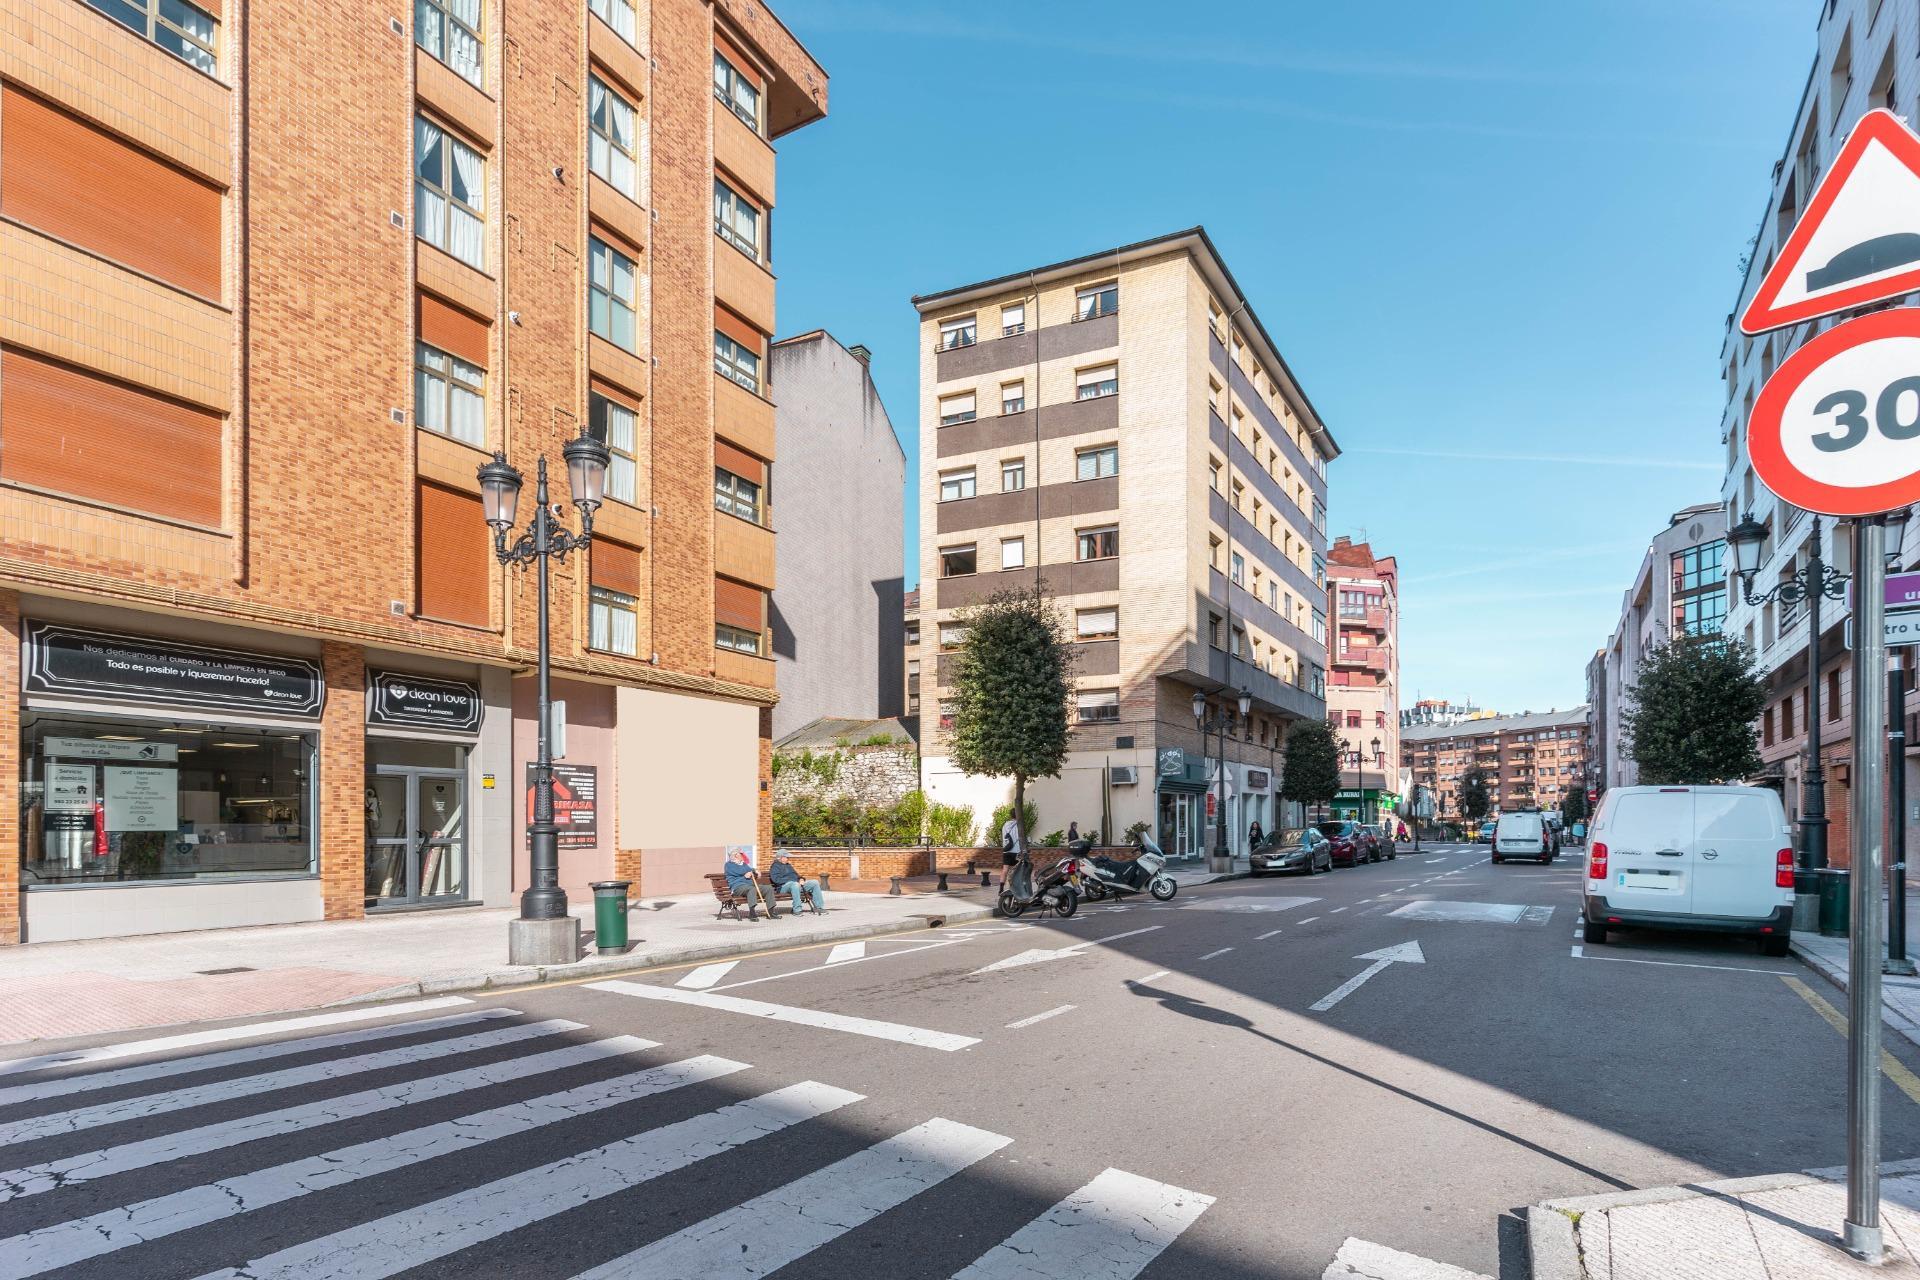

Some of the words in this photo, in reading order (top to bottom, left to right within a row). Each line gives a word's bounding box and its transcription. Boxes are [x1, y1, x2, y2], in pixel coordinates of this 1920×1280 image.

[1811, 373, 1920, 453] 30
[83, 644, 104, 654] Nos
[106, 647, 157, 660] dedicamos
[169, 656, 204, 666] CUIDADO
[213, 661, 223, 669] LA
[224, 663, 255, 673] LIMPIEZA
[269, 669, 286, 677] SECO
[106, 659, 130, 670] Todo
[132, 664, 144, 672] es
[146, 665, 179, 675] posible
[180, 670, 186, 678] y
[236, 675, 270, 686] hacerlo!
[273, 690, 289, 698] clean
[290, 692, 303, 700] love
[409, 688, 440, 702] clean
[443, 691, 467, 705] love
